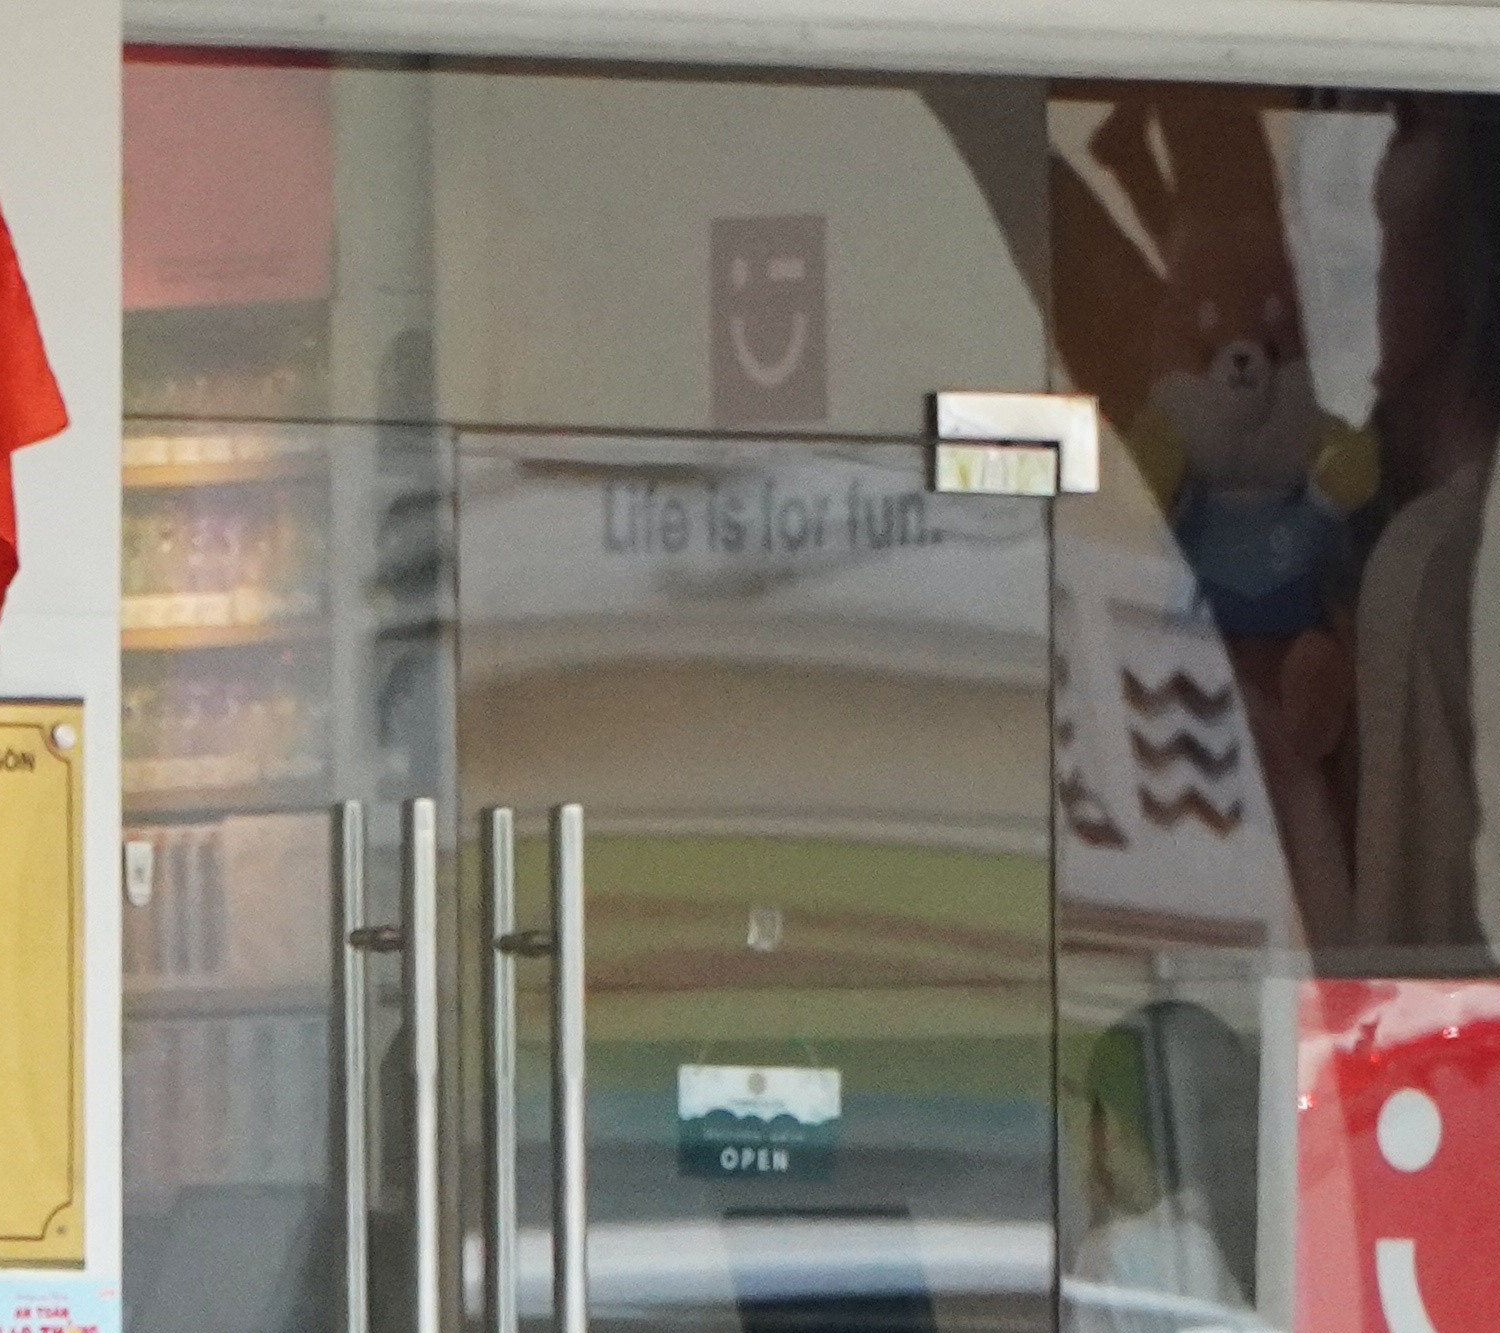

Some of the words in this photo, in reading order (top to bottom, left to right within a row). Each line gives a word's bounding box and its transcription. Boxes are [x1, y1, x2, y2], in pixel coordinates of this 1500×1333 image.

[605, 481, 691, 554] Life
[705, 485, 751, 554] is
[762, 480, 828, 553] for
[719, 1147, 790, 1171] OPEN
